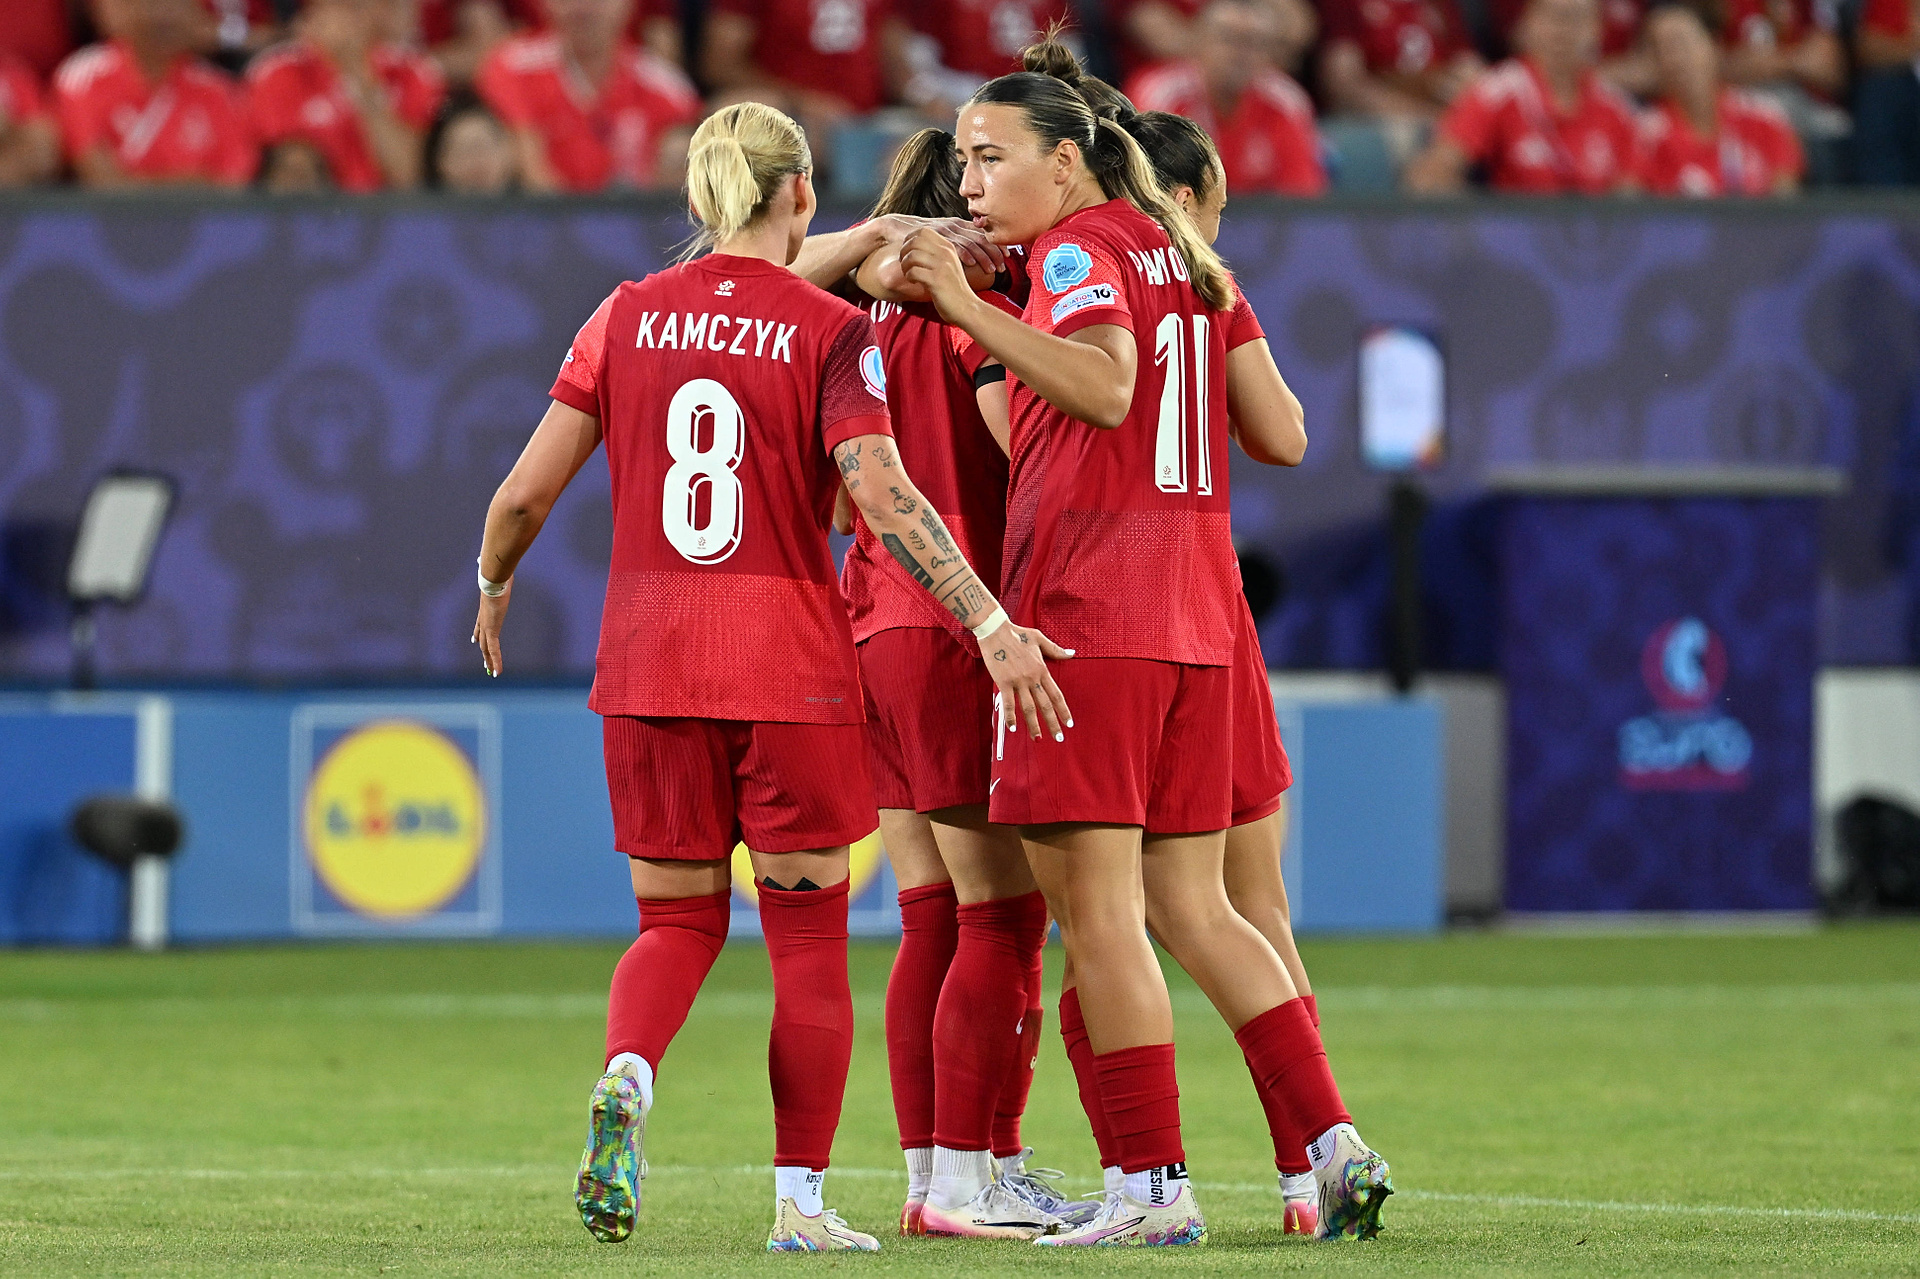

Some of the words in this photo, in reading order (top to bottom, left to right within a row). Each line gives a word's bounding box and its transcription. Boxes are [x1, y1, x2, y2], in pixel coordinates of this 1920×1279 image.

[1127, 245, 1191, 286] PAWO
[635, 311, 798, 364] KAMCZYK
[1154, 312, 1213, 496] 11
[662, 378, 746, 566] 8
[811, 1184, 817, 1196] 8
